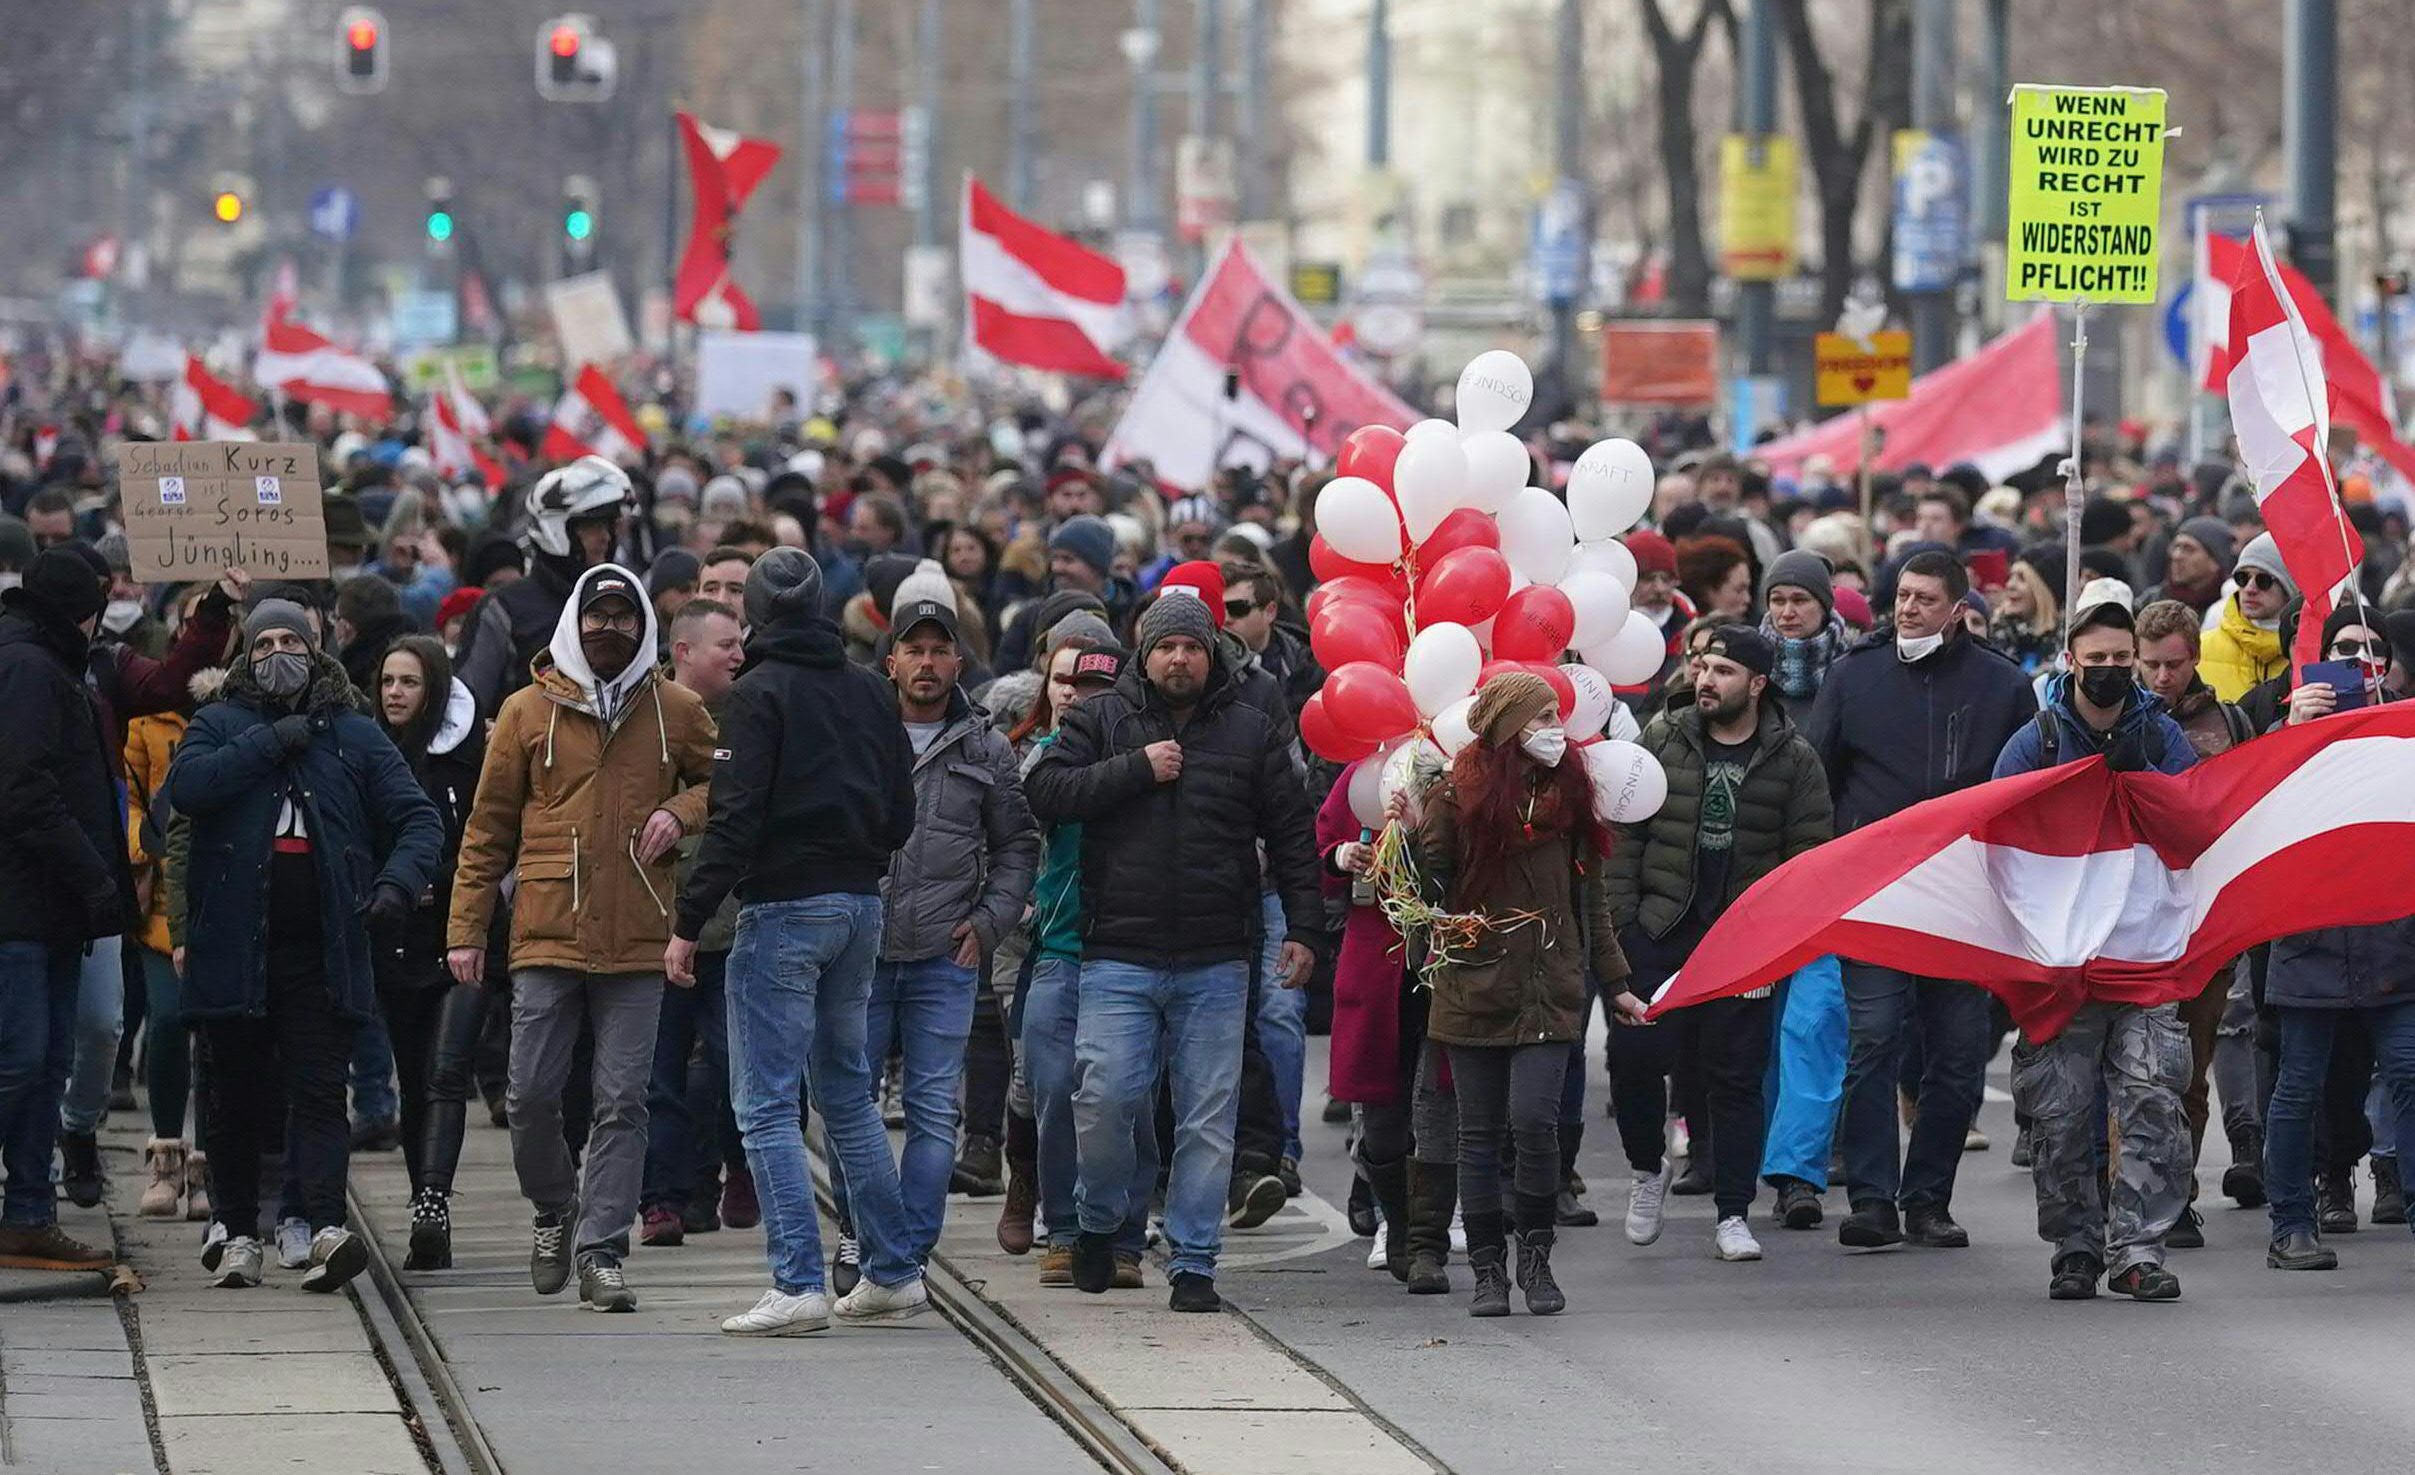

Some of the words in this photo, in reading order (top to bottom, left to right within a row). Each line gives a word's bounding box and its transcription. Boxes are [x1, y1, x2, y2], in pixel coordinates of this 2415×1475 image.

[2055, 95, 2126, 116] WENN
[2027, 118, 2160, 143] UNRECHT
[2038, 146, 2100, 167] WIRD
[2107, 149, 2139, 167] ZU
[2038, 172, 2146, 194] RECHT
[2070, 201, 2102, 217] IST
[2022, 222, 2152, 256] WIDERSTAND
[2021, 262, 2147, 291] PFLICHT!!
[224, 446, 297, 474] Kurz
[134, 499, 194, 519] George
[215, 498, 294, 525] Soros
